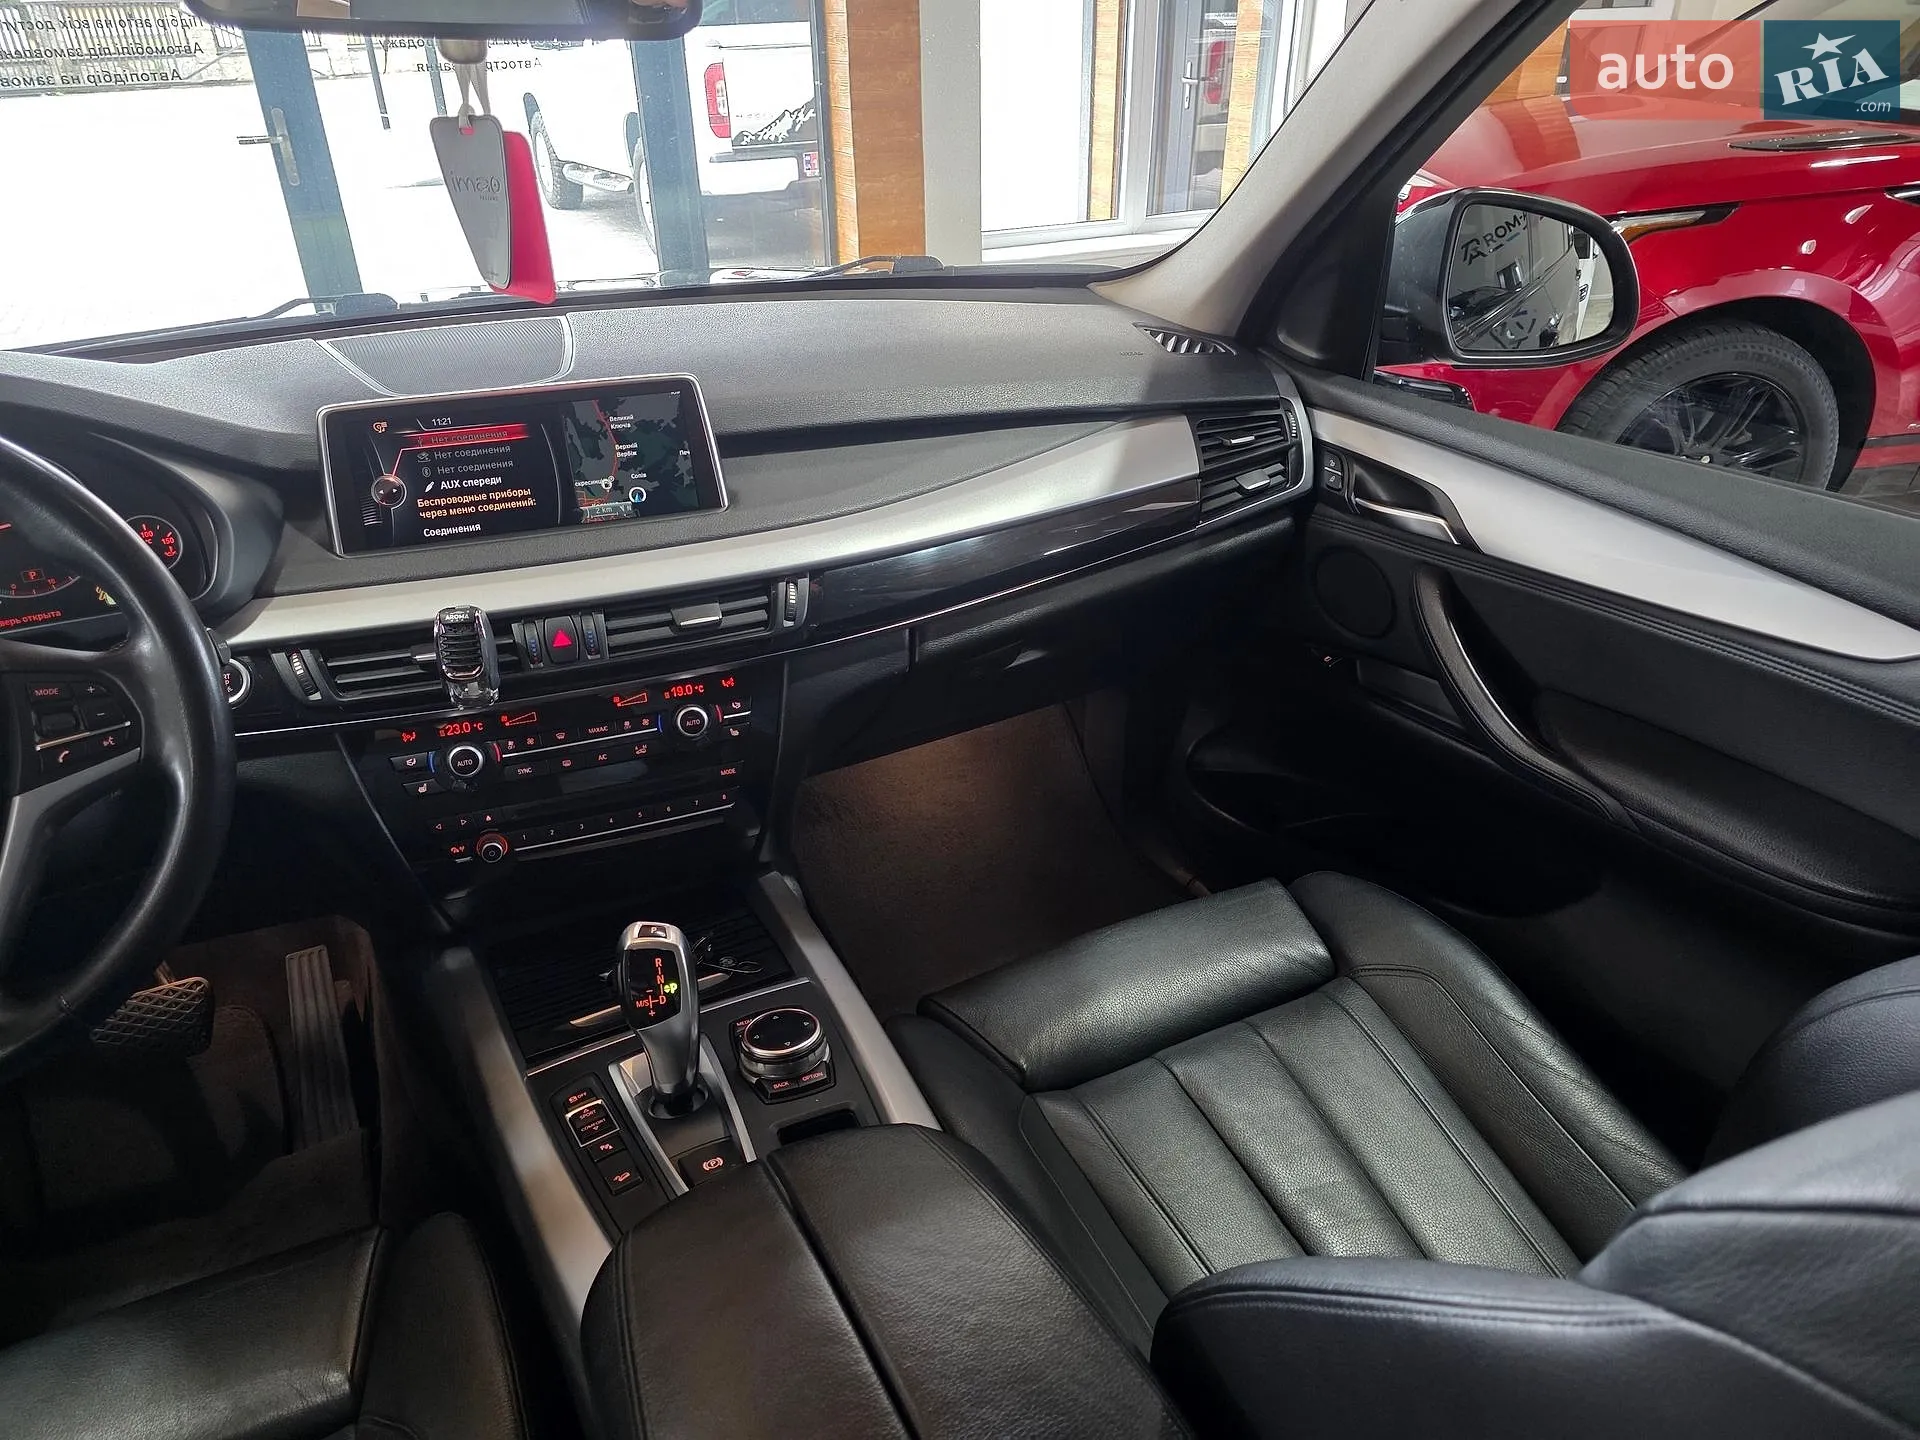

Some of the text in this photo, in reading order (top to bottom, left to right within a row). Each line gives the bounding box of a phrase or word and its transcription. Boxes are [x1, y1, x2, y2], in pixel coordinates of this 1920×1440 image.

[431, 417, 452, 426] 11:21
[431, 430, 508, 444] Нет соединения
[434, 445, 511, 460] Нет соединения
[437, 460, 514, 475] Нет соединения
[440, 476, 503, 490] AUX спереди
[417, 488, 532, 508] Беспроводные приборы
[420, 498, 537, 520] через меню соединений:
[601, 505, 613, 514] km
[423, 523, 482, 537] Соединения
[161, 536, 175, 545] 150
[28, 571, 37, 580] P
[22, 610, 62, 623] открыта
[34, 687, 59, 697] MODE
[671, 684, 693, 698] 19.0
[686, 719, 701, 727] AUTO
[446, 722, 471, 736] 23.0
[457, 759, 473, 768] AUTO
[517, 767, 533, 775] SYNC
[654, 957, 662, 968] R
[656, 974, 665, 985] N
[635, 995, 667, 1008] M/S D
[801, 1071, 824, 1082] OPTION
[773, 1081, 790, 1090] BACK
[580, 1109, 597, 1120] SPORT
[581, 1118, 606, 1132] COMFORT
